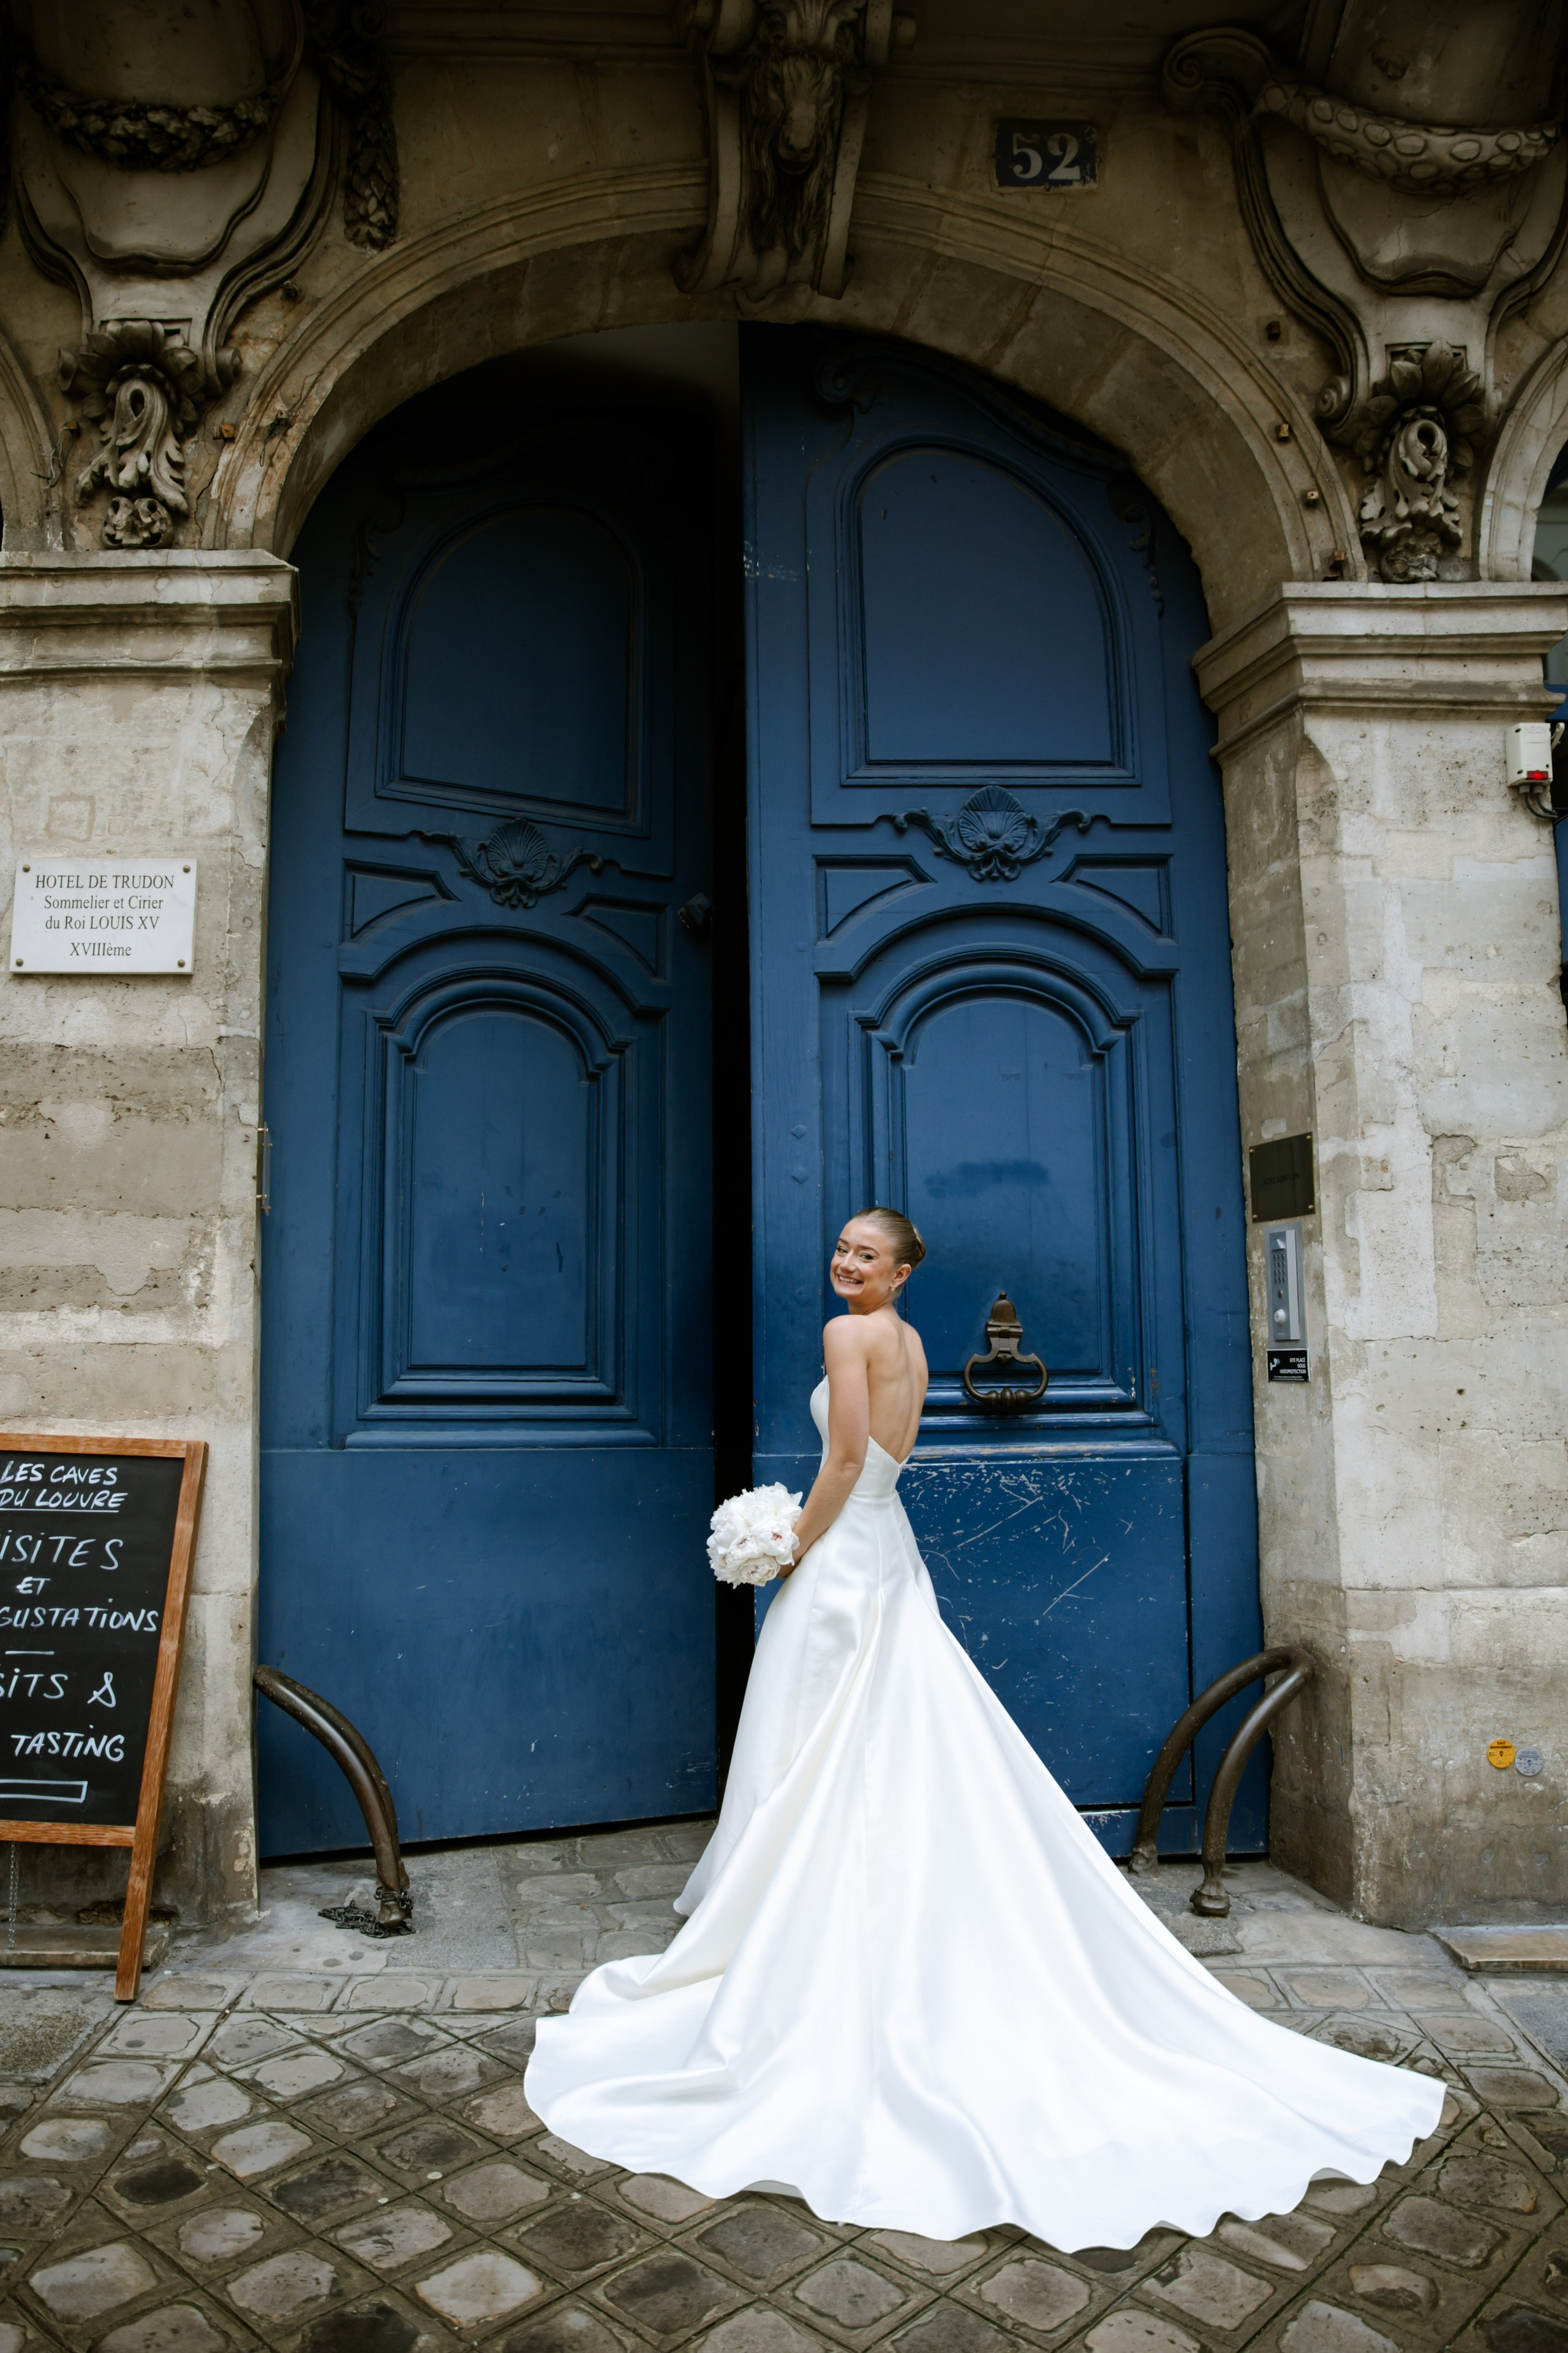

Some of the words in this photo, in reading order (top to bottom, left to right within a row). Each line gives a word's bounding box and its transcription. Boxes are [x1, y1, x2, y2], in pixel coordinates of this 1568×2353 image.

[1012, 132, 1080, 179] 52
[35, 875, 84, 888] HOTEL
[88, 875, 108, 888] DE
[112, 875, 175, 889] TRUDON
[44, 895, 110, 909] Sommelier
[113, 897, 124, 909] et
[128, 895, 164, 909] Cirier
[45, 916, 60, 929] du
[64, 916, 86, 929] Roi
[89, 916, 134, 930] LOUIS
[137, 916, 160, 929] XV
[69, 942, 132, 956] XVIIIème
[0, 1460, 45, 1484] LES
[50, 1465, 118, 1486] CAVES
[0, 1488, 30, 1507] DU
[36, 1489, 128, 1509] LOUVRE
[16, 1576, 51, 1595] ET
[87, 1671, 116, 1708] &
